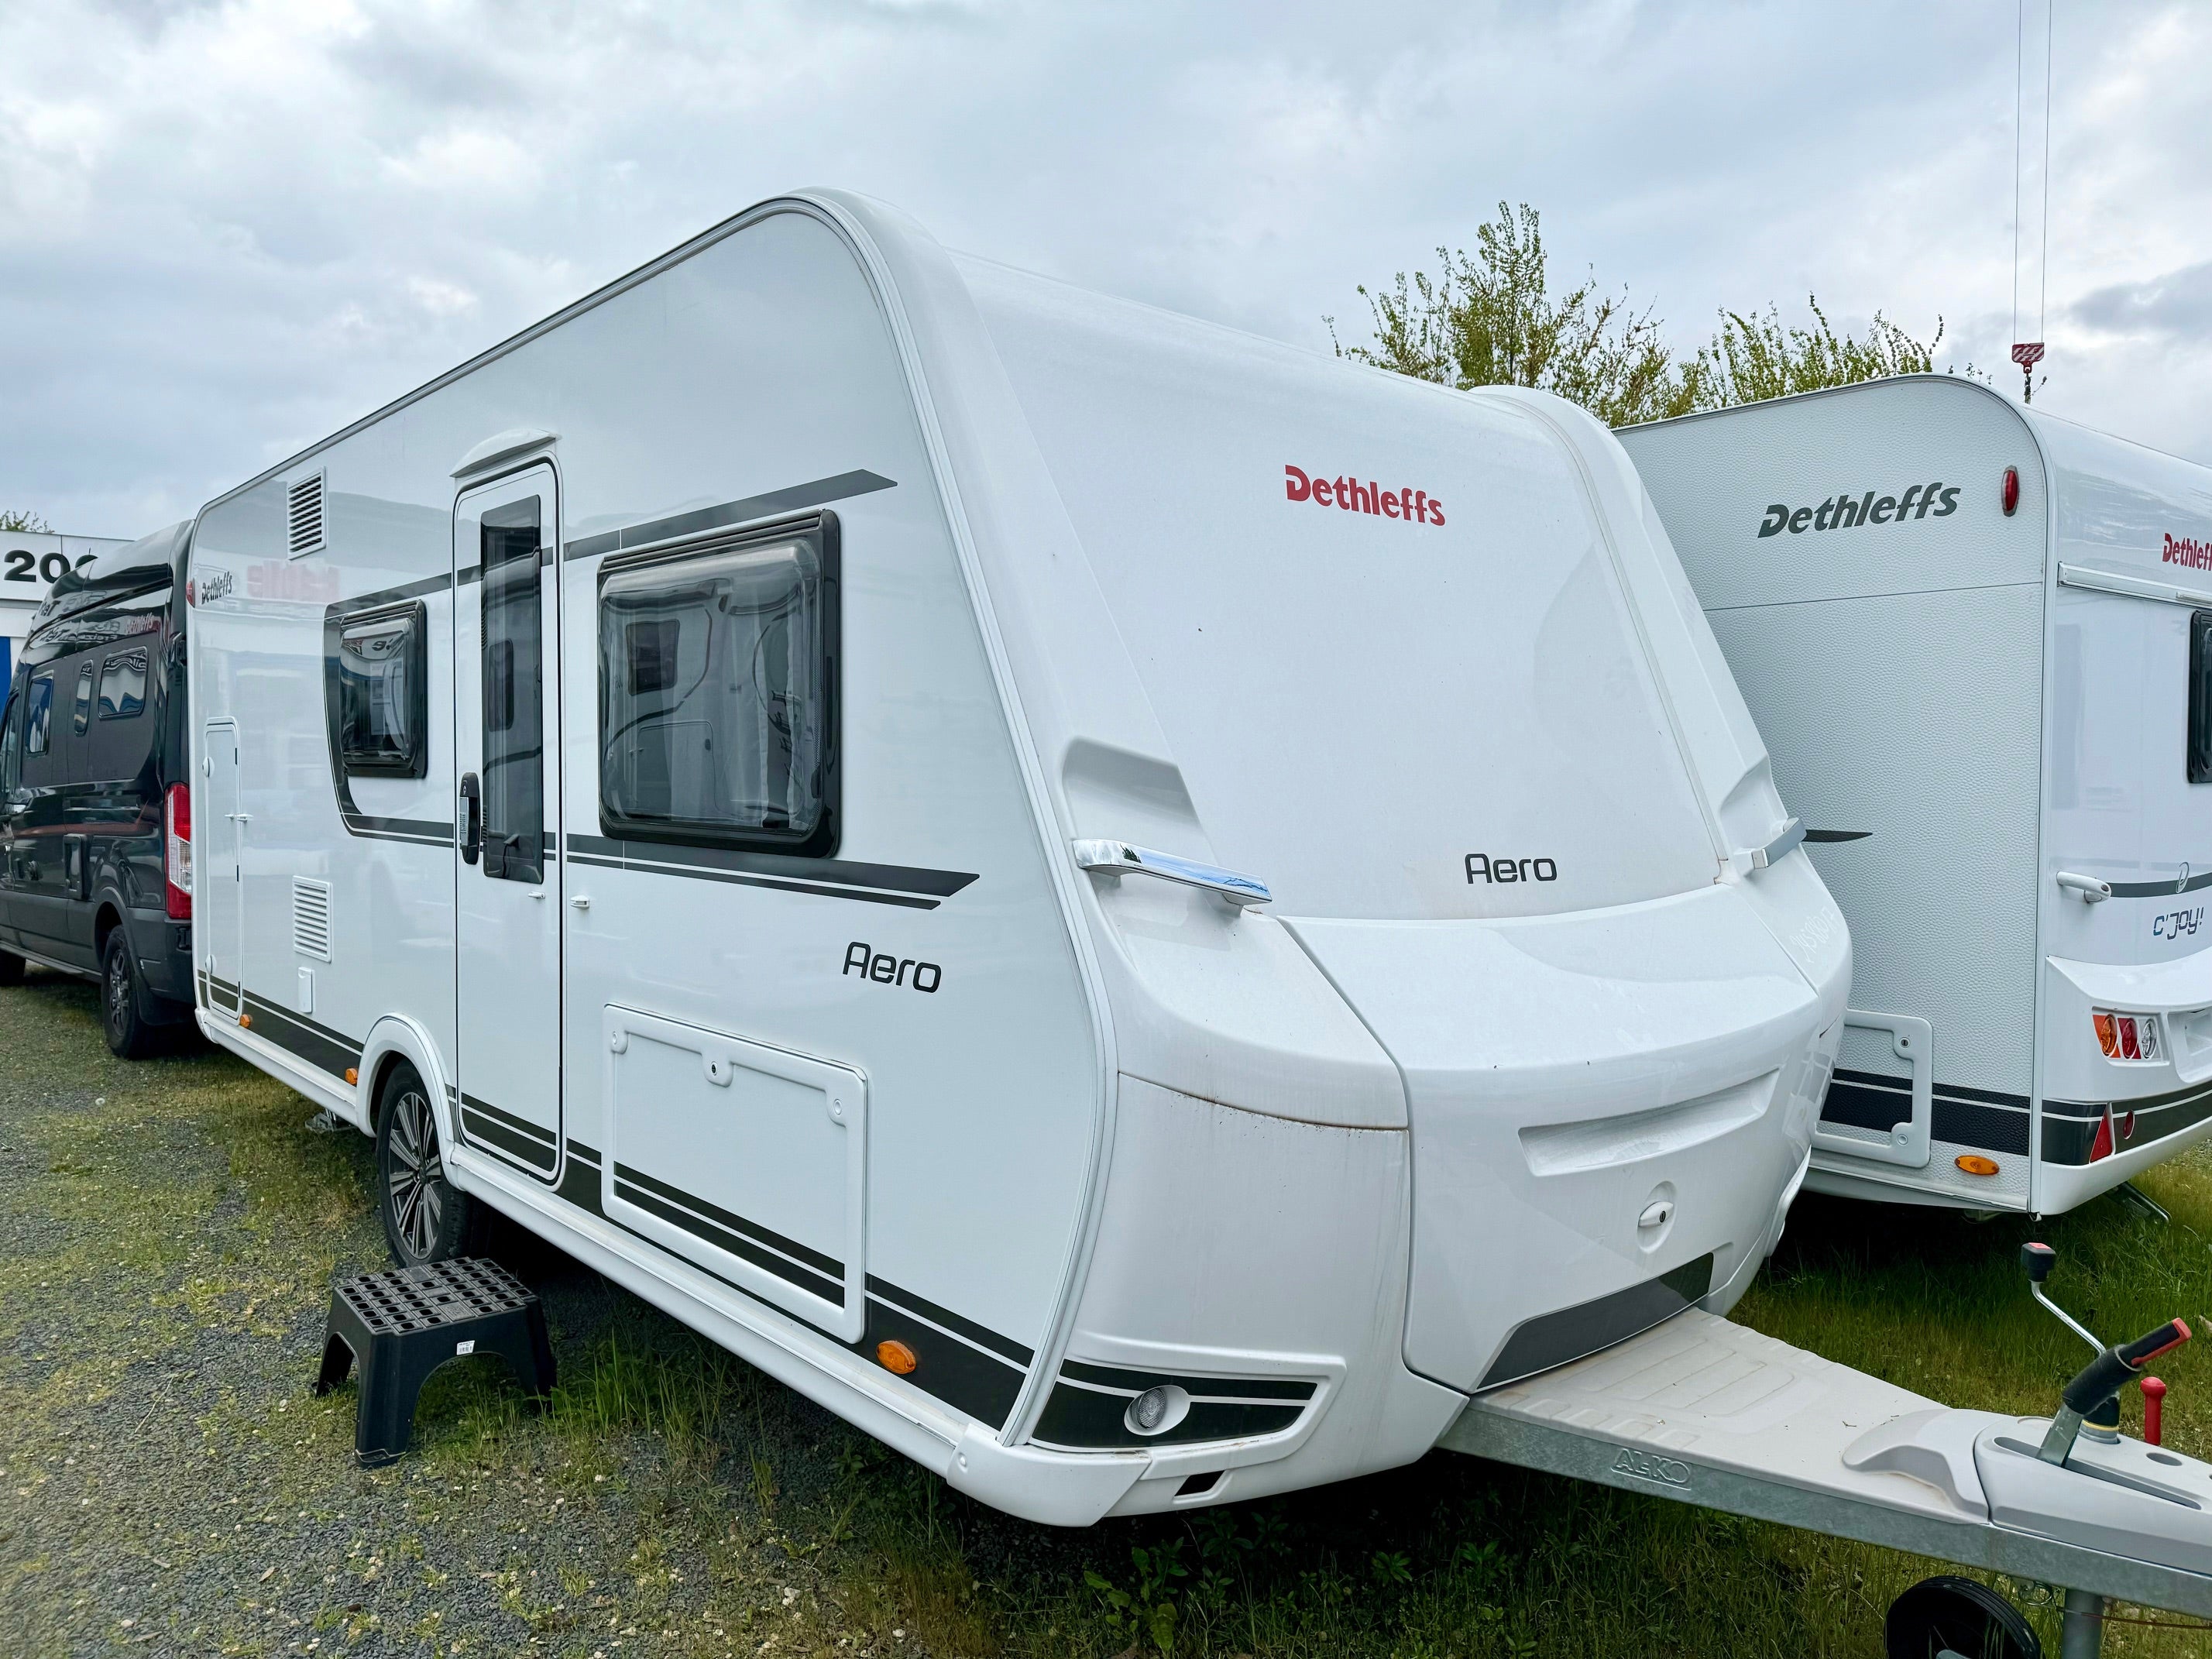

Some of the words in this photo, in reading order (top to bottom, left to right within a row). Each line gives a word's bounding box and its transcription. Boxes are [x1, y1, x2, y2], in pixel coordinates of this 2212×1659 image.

[1285, 465, 1446, 527] Dethleffs
[1757, 482, 1961, 538] Dethleffs
[4, 550, 98, 583] 20
[201, 571, 232, 605] Dethleffs
[1465, 854, 1557, 884] Aero
[843, 942, 942, 993] Aero
